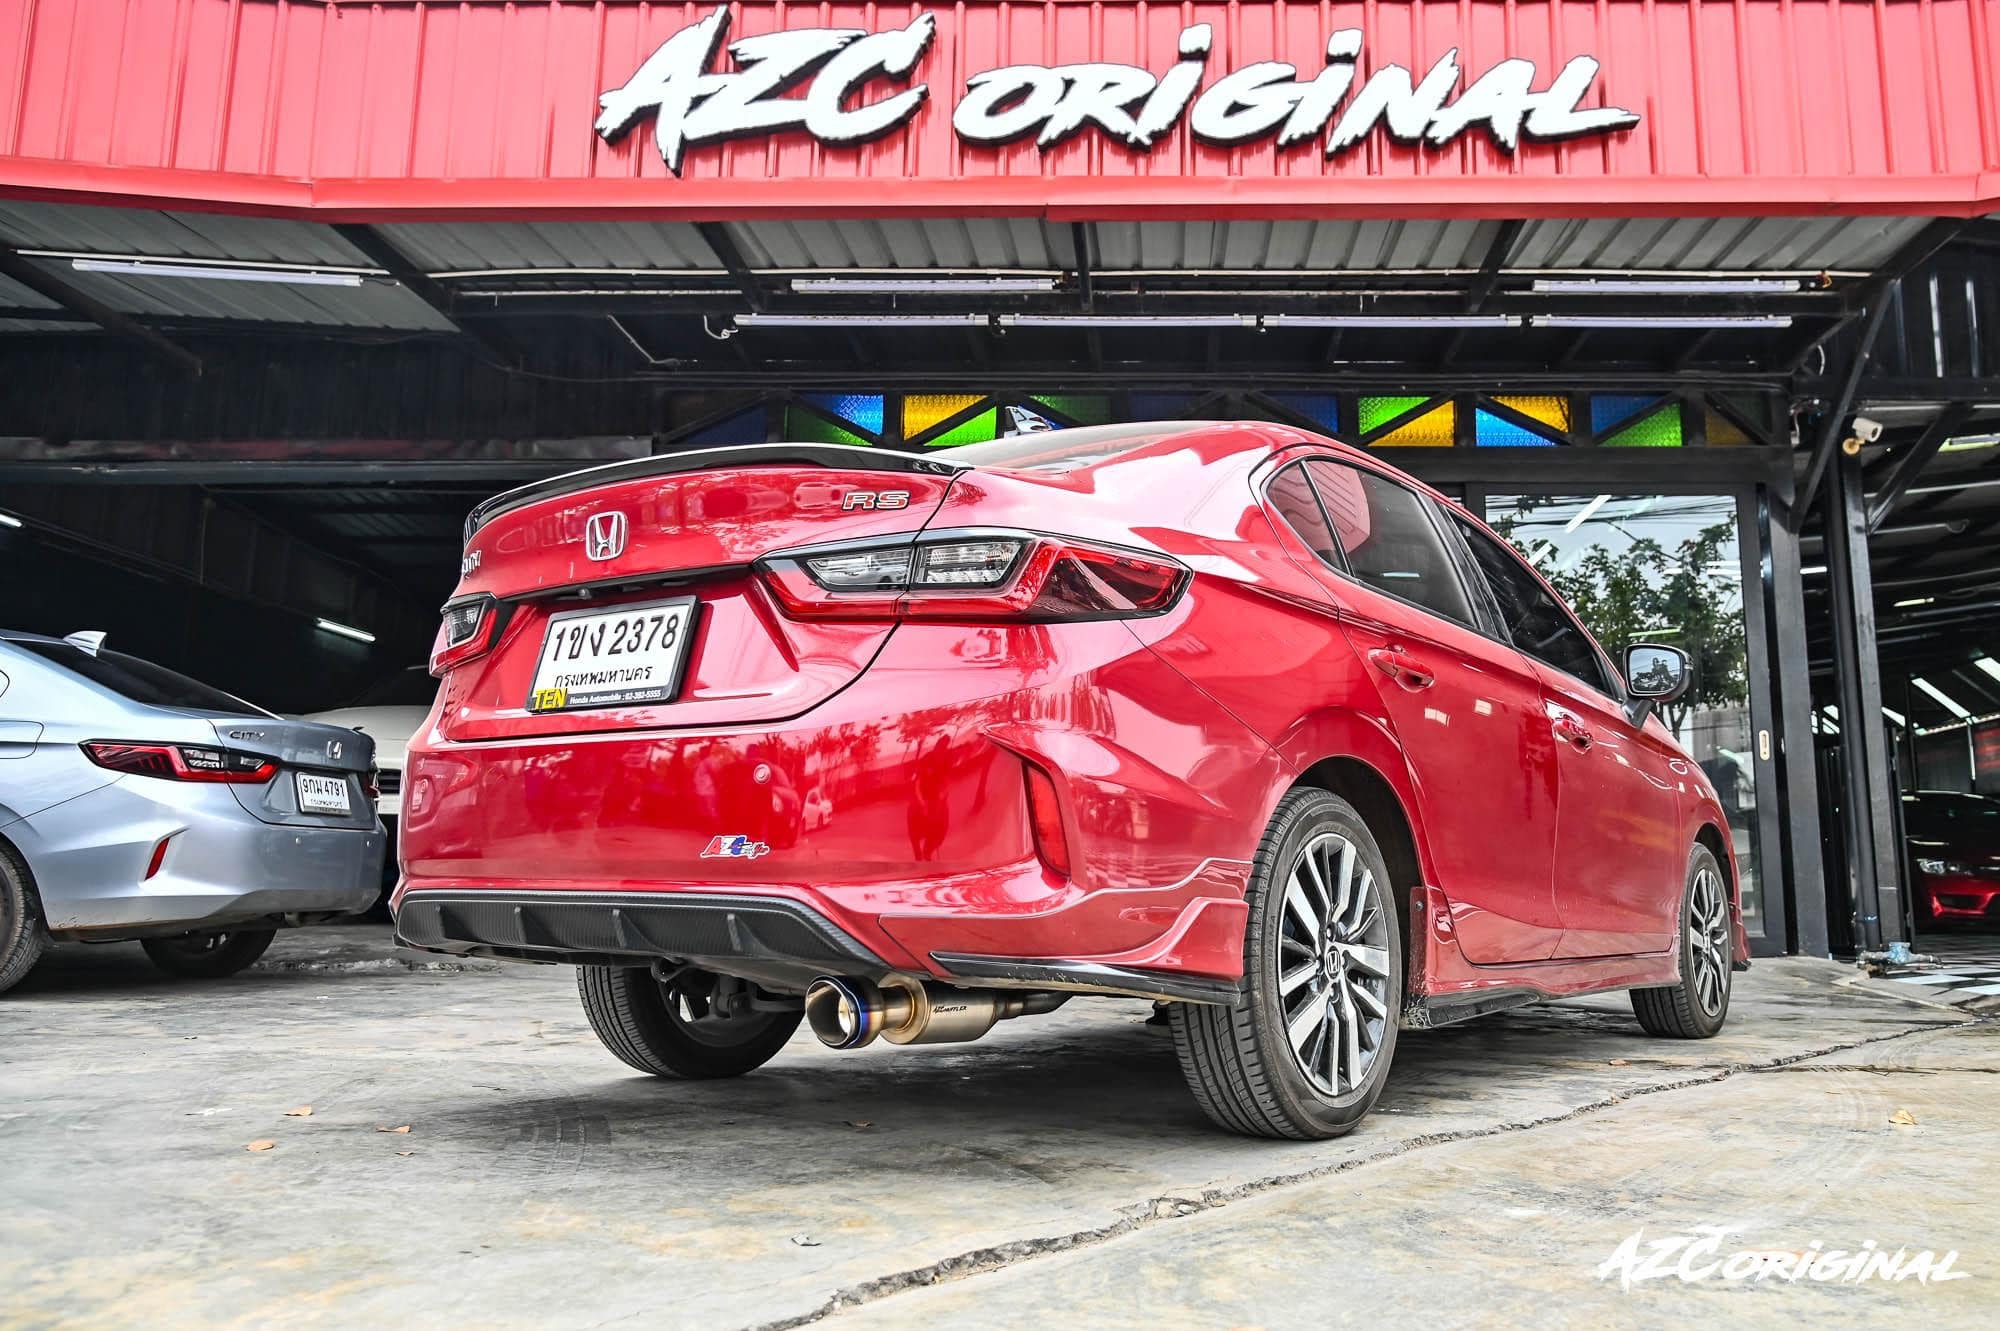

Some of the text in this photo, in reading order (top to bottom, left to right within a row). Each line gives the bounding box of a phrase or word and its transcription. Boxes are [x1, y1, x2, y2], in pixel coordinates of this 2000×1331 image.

[595, 4, 935, 177] AZC
[843, 490, 910, 510] RS
[608, 613, 680, 656] 2378
[554, 665, 653, 688] กรงเทพมหานคร
[534, 688, 568, 710] TEN
[229, 730, 265, 740] CITY
[325, 779, 345, 798] 4791
